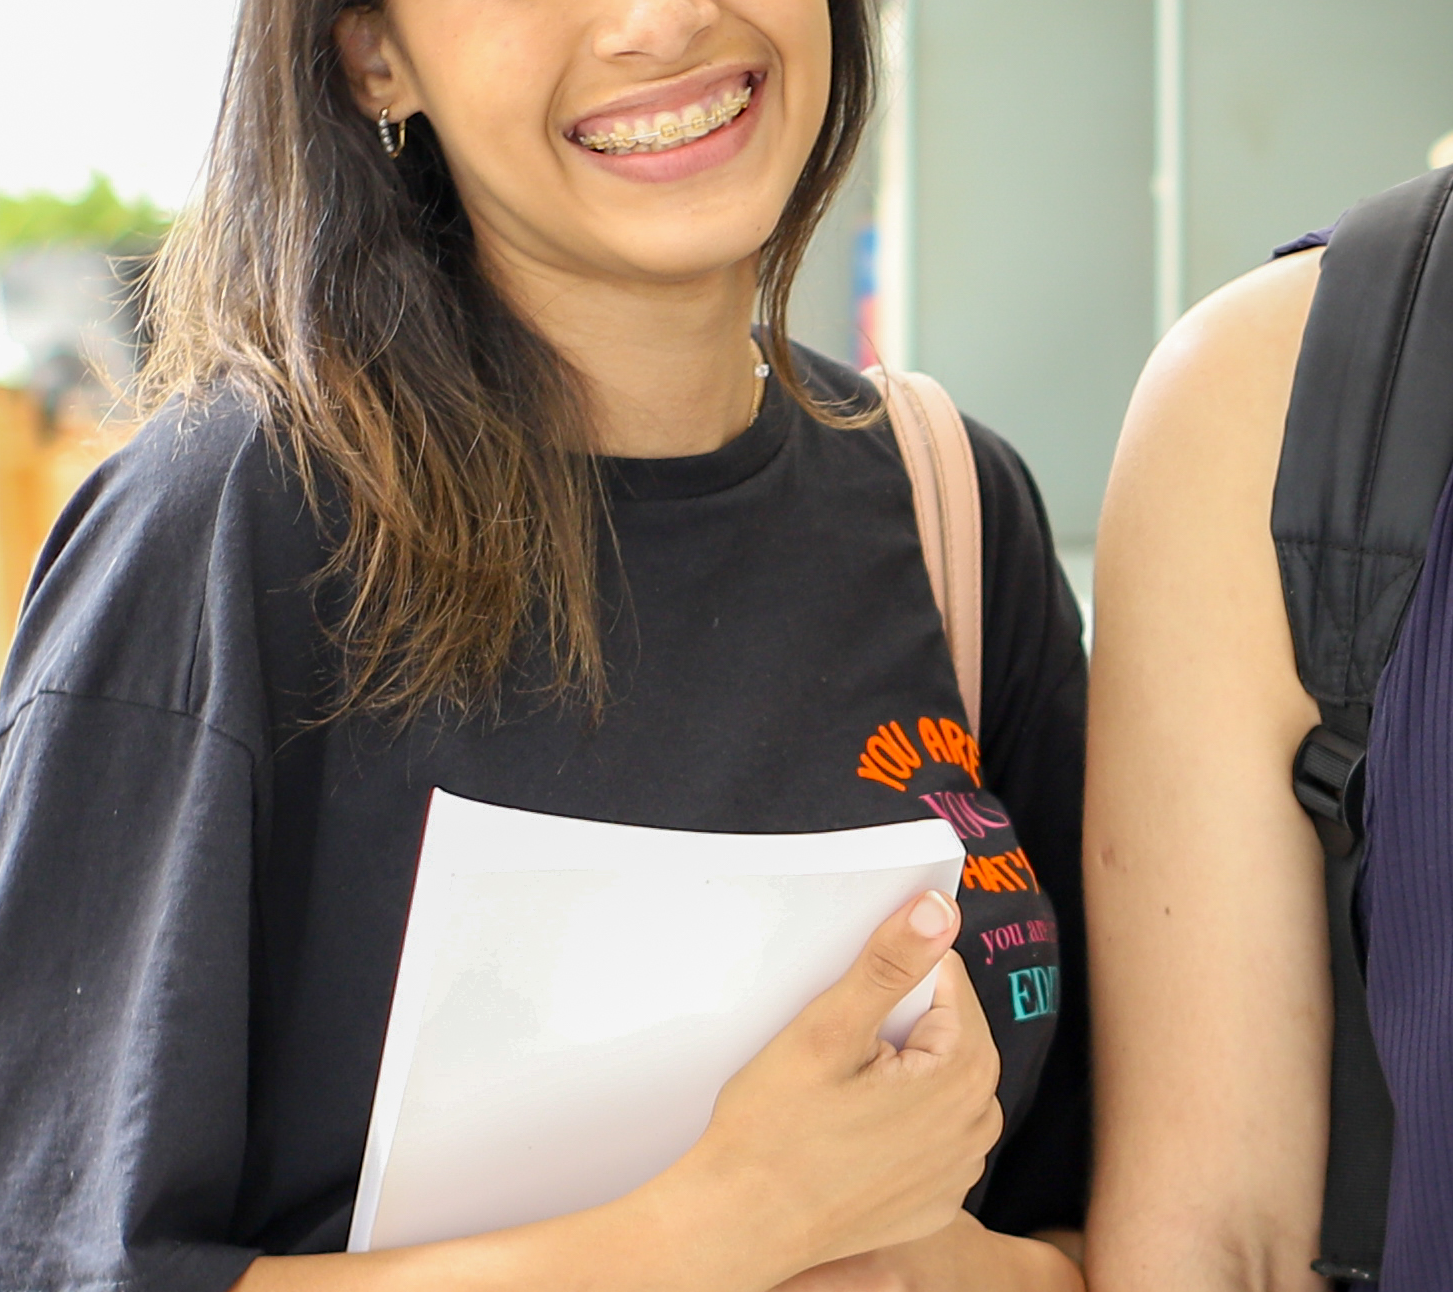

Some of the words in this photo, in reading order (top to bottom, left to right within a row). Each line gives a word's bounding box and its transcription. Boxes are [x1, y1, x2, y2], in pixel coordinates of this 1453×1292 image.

[856, 719, 922, 792] YOU
[917, 715, 982, 789] ARE
[962, 853, 1028, 893] HAT
[980, 922, 1026, 966] you
